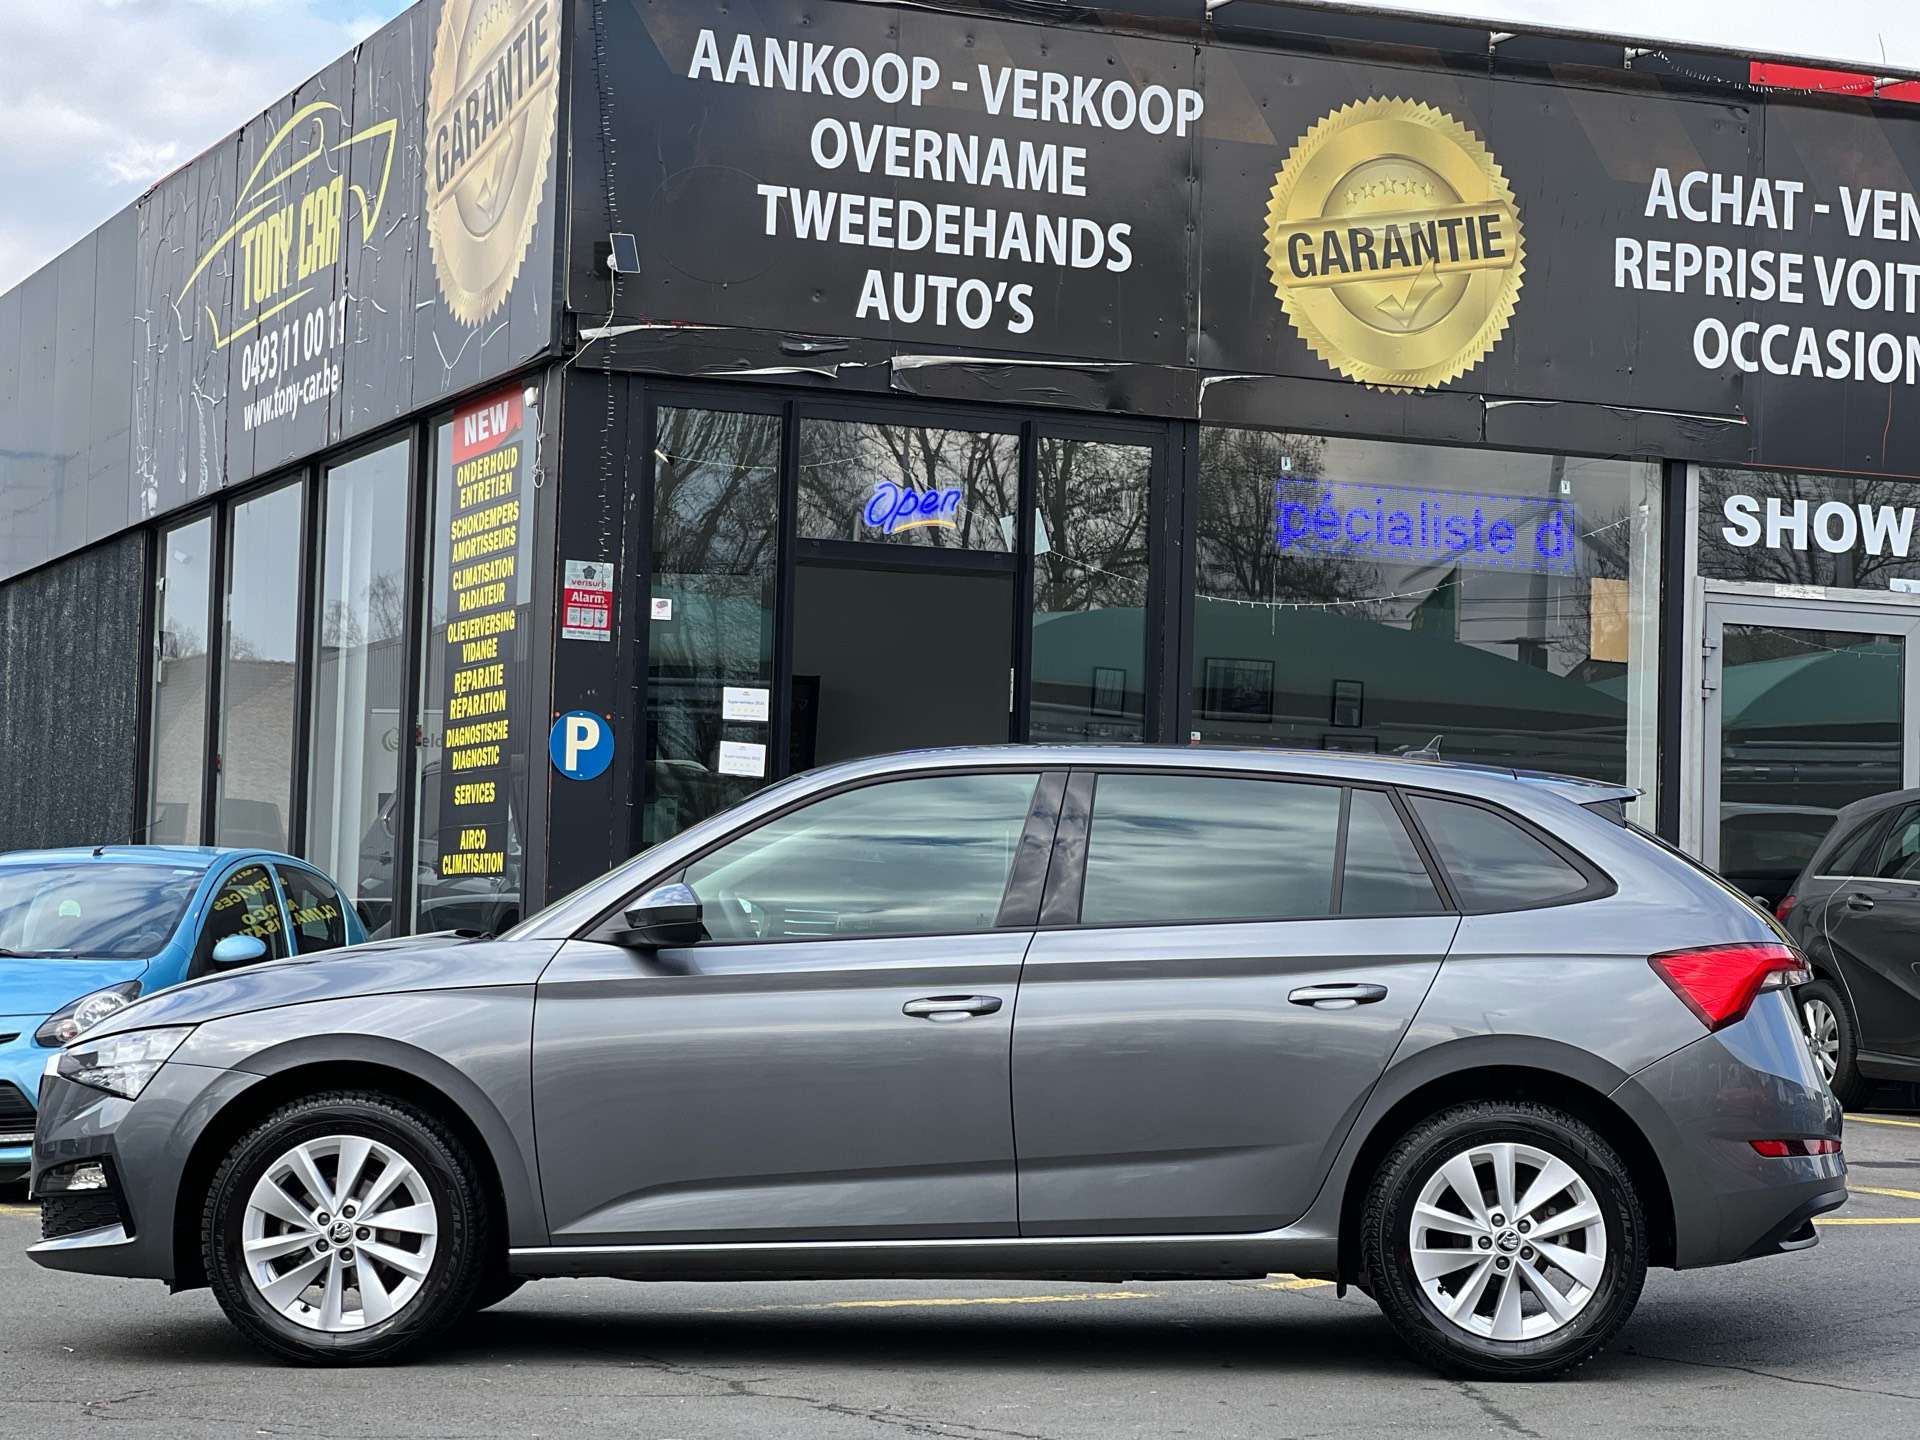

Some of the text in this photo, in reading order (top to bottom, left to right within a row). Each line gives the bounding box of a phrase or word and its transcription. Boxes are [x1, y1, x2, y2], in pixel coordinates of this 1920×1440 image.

[435, 3, 549, 192] GARANTIE
[688, 29, 940, 107] AANKOOP
[978, 64, 1205, 137] VERKOOP
[810, 118, 1087, 197] OVERNAME
[1644, 168, 1804, 231] ACHAT
[240, 175, 344, 311] TONY CAR
[757, 184, 1132, 273] TWEEDEHANDS
[1287, 213, 1506, 279] GARANTIE
[1615, 237, 1920, 313] REPRISE VOIT
[855, 269, 1035, 334] AUTO'S
[241, 295, 347, 391] 0493 11 00 11
[243, 357, 340, 431] www.tony-car.be
[464, 401, 509, 447] NEW
[457, 447, 518, 488] ONDERHOUD
[460, 472, 513, 509] ENTRETIEN
[865, 481, 962, 534] Open
[450, 500, 520, 541] SCHOKDEMPERS
[1278, 489, 1516, 557] pécialiste
[1722, 494, 1916, 557] SHOW
[452, 525, 517, 564] AMORTISSEURS
[453, 555, 515, 592] CLIMATISATION
[570, 578, 607, 588] verisure
[459, 583, 506, 612] RADIATEUR
[571, 591, 605, 604] Alarm
[447, 611, 515, 644] OLIEVERVERSING
[462, 637, 497, 664] VIDANGE
[454, 664, 504, 694] REPARATIE
[446, 719, 509, 749] DIAGNOSTISCHE
[565, 716, 600, 772] P
[452, 747, 500, 771] DIAGNOSTIC
[454, 782, 496, 806] SERVICES
[460, 829, 487, 850] AIRCO
[442, 852, 504, 876] CLIMATISATION
